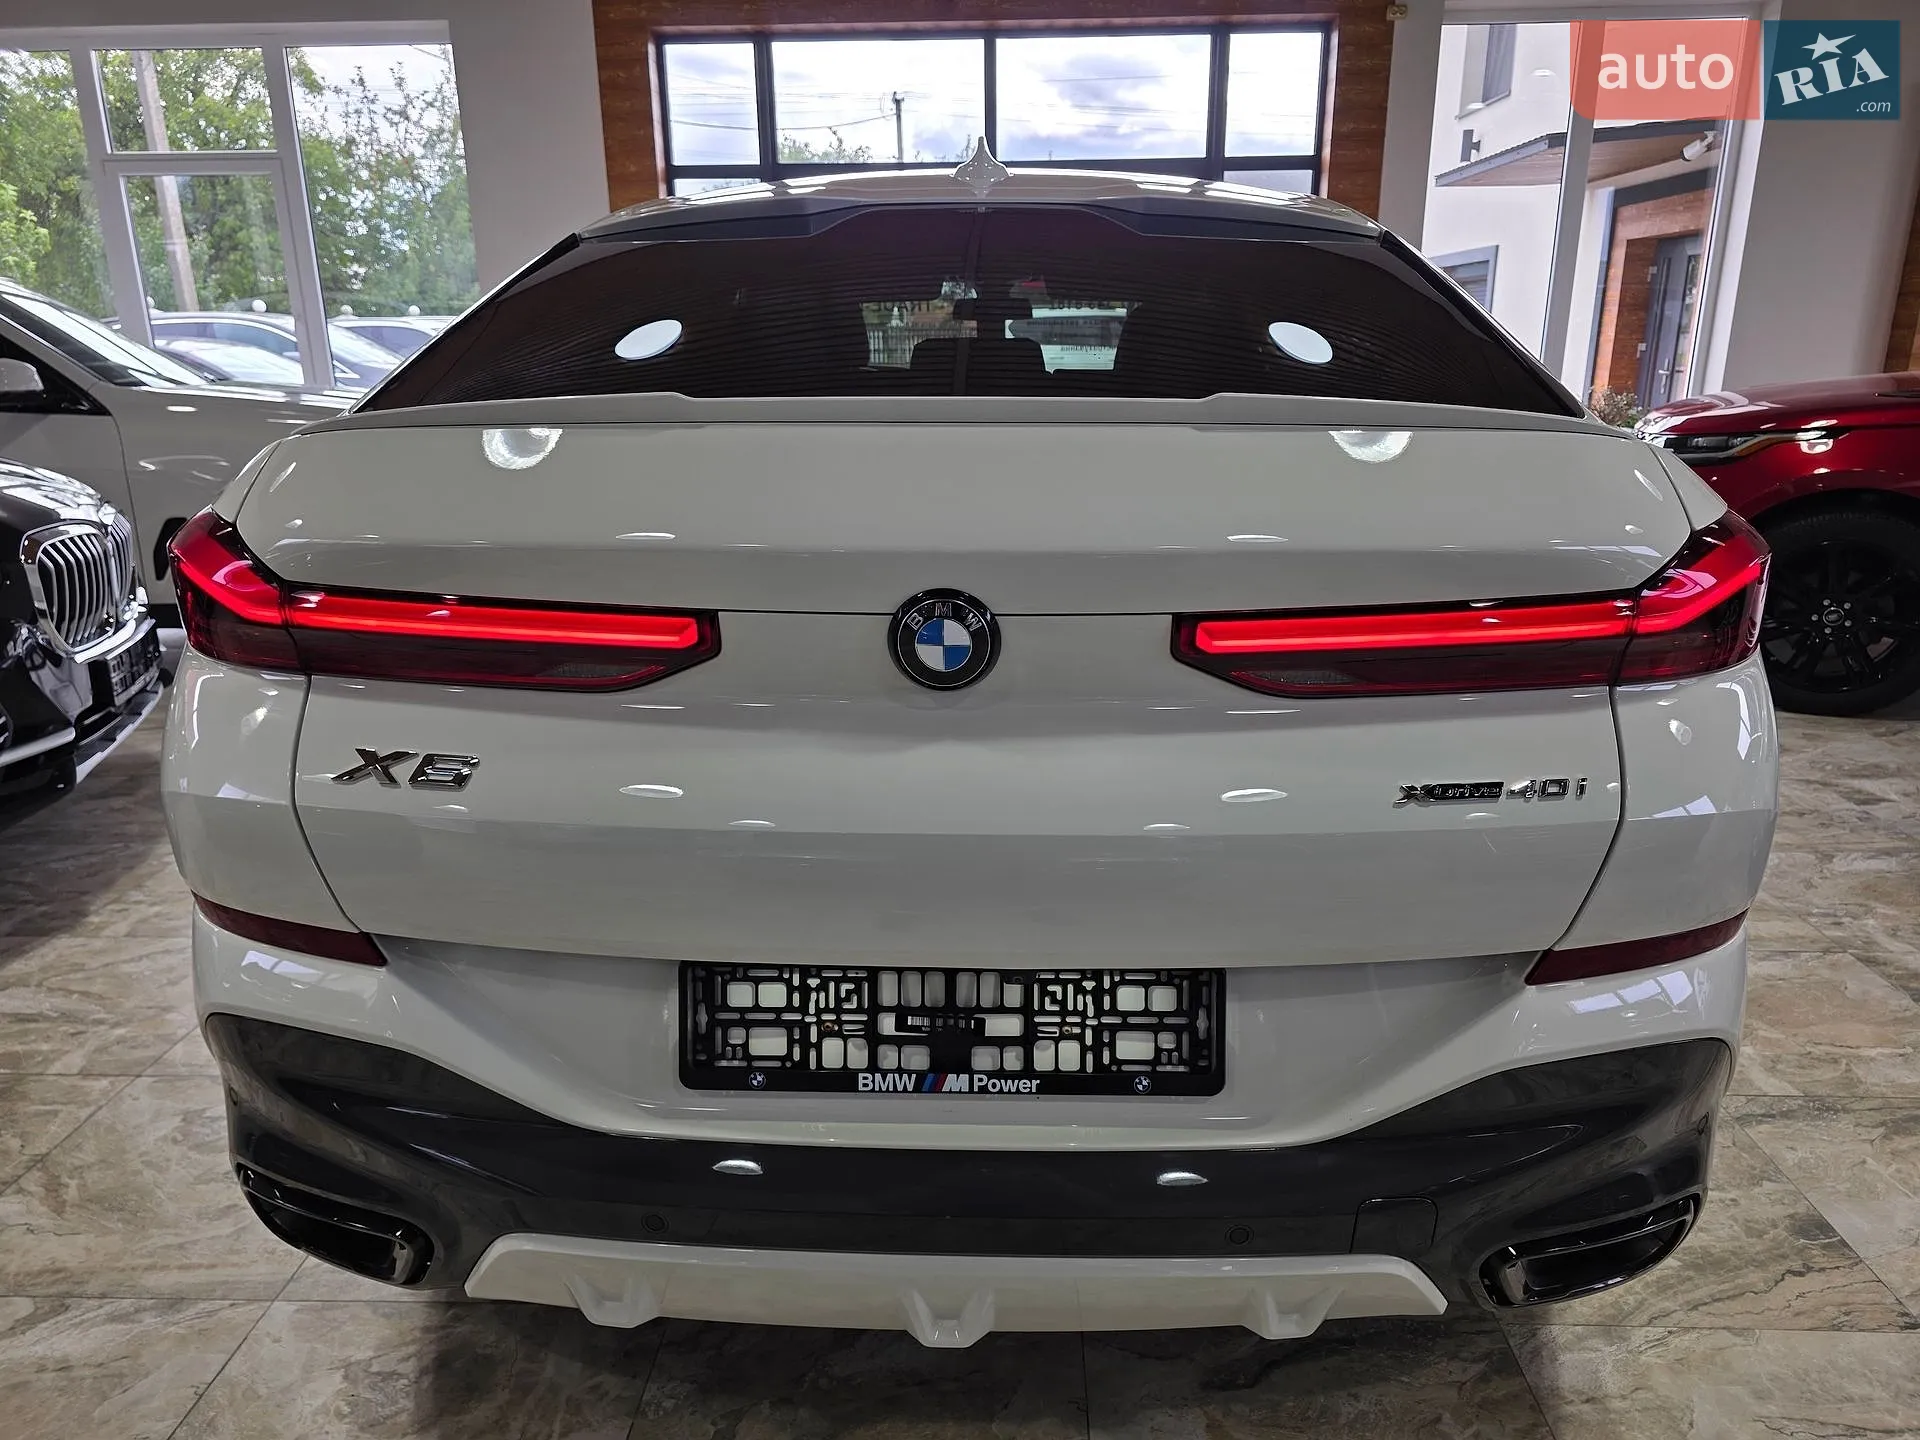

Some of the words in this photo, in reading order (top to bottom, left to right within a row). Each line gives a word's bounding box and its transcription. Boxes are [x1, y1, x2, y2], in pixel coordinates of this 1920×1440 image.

[906, 602, 983, 632] BMW
[331, 748, 481, 792] X6
[857, 1073, 917, 1092] BMW
[973, 1074, 1041, 1093] Power
